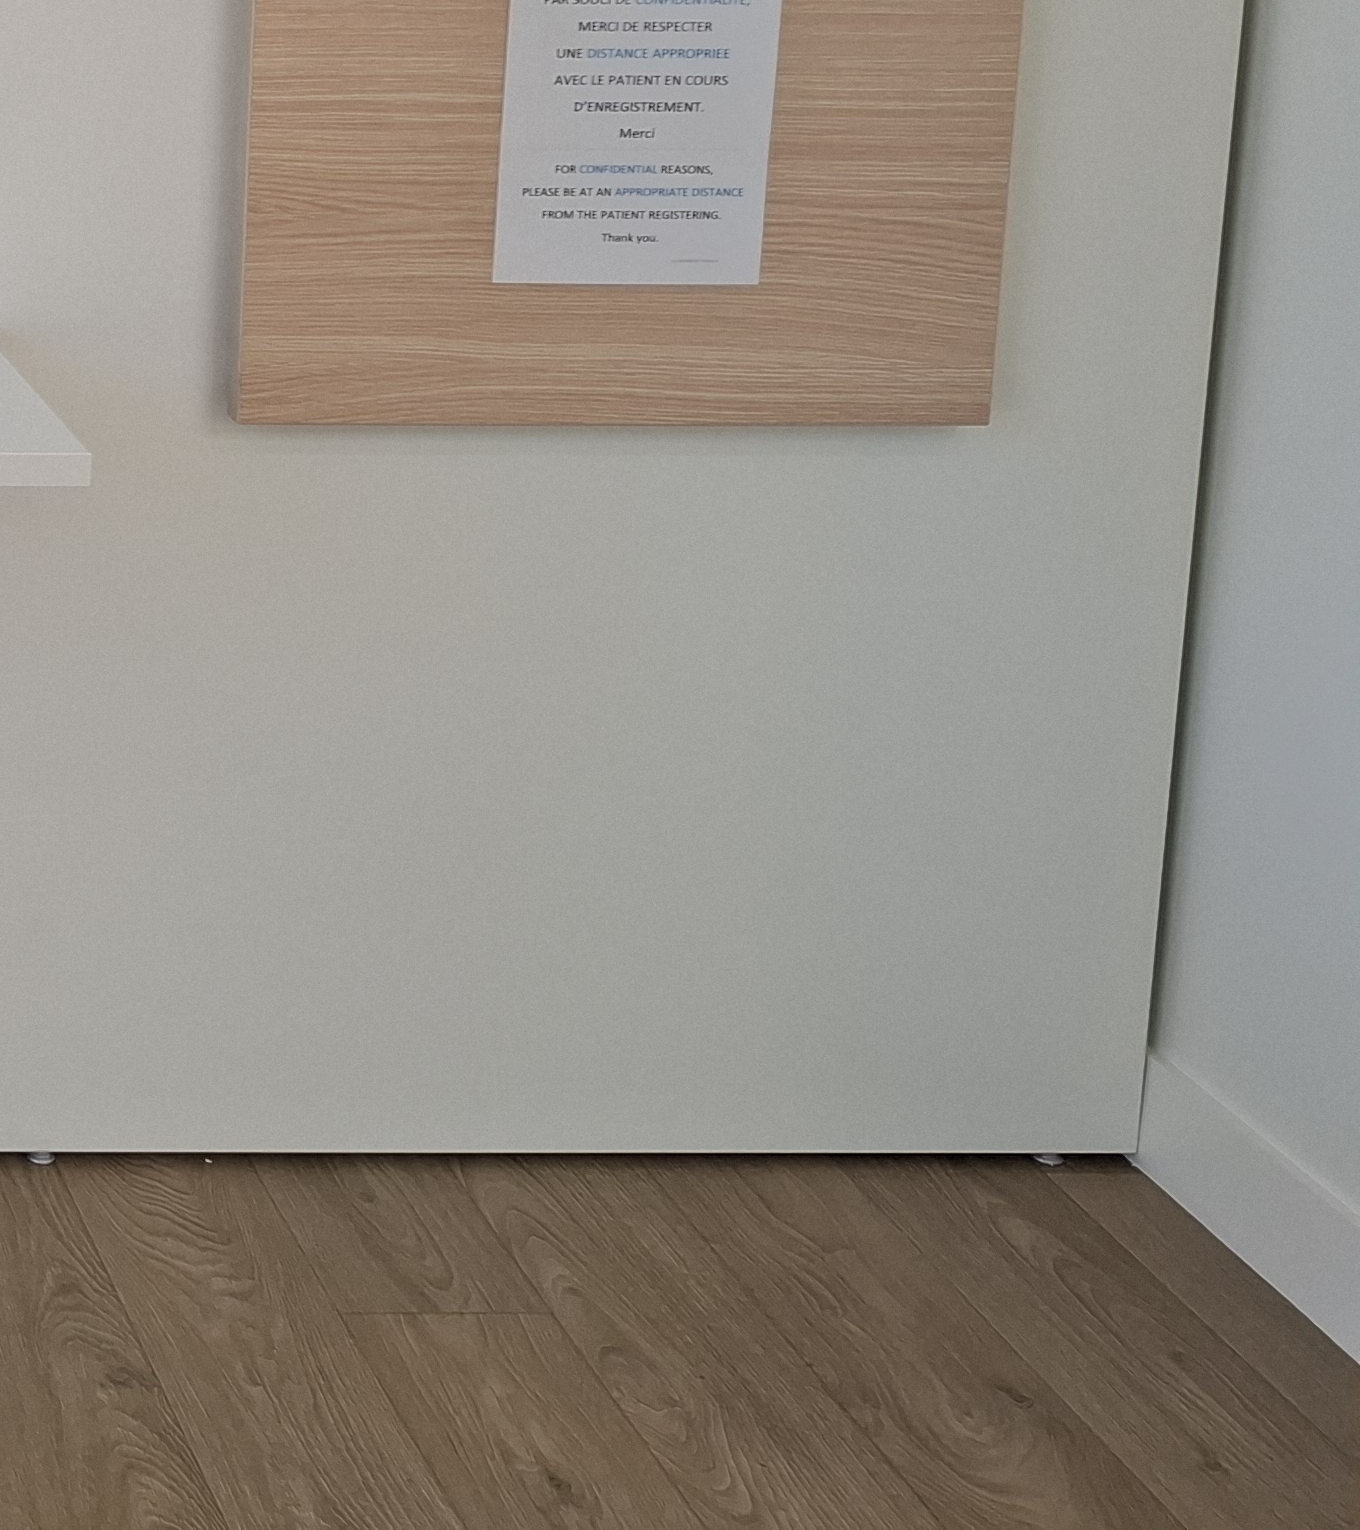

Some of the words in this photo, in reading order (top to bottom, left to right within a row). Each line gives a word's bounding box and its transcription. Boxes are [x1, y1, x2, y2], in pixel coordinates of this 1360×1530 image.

[578, 21, 619, 32] MERCI
[623, 21, 639, 32] DE
[644, 21, 712, 32] RESPECTER
[556, 48, 583, 59] UNE
[587, 48, 648, 59] DISTANCE
[652, 48, 730, 59] APPROPRIEE
[554, 75, 588, 86] AVEC
[591, 75, 604, 86] LE
[609, 75, 661, 86] PATIENT
[664, 75, 681, 86] EN
[685, 75, 729, 86] COURS
[619, 128, 655, 139] Merci
[555, 165, 576, 174] FOR
[580, 165, 657, 174] CONFIDENTIAL
[661, 165, 713, 175] REASONS,
[522, 187, 559, 197] PLEASE
[563, 187, 576, 197] BE
[580, 187, 593, 197] AT
[596, 187, 612, 197] AN
[615, 187, 688, 197] APPROPRIATE
[692, 187, 744, 197] DISTANCE
[542, 210, 574, 220] FROM
[577, 210, 597, 220] THE
[601, 210, 645, 220] PATIENT
[601, 233, 633, 242] Thank
[636, 233, 659, 244] you.
